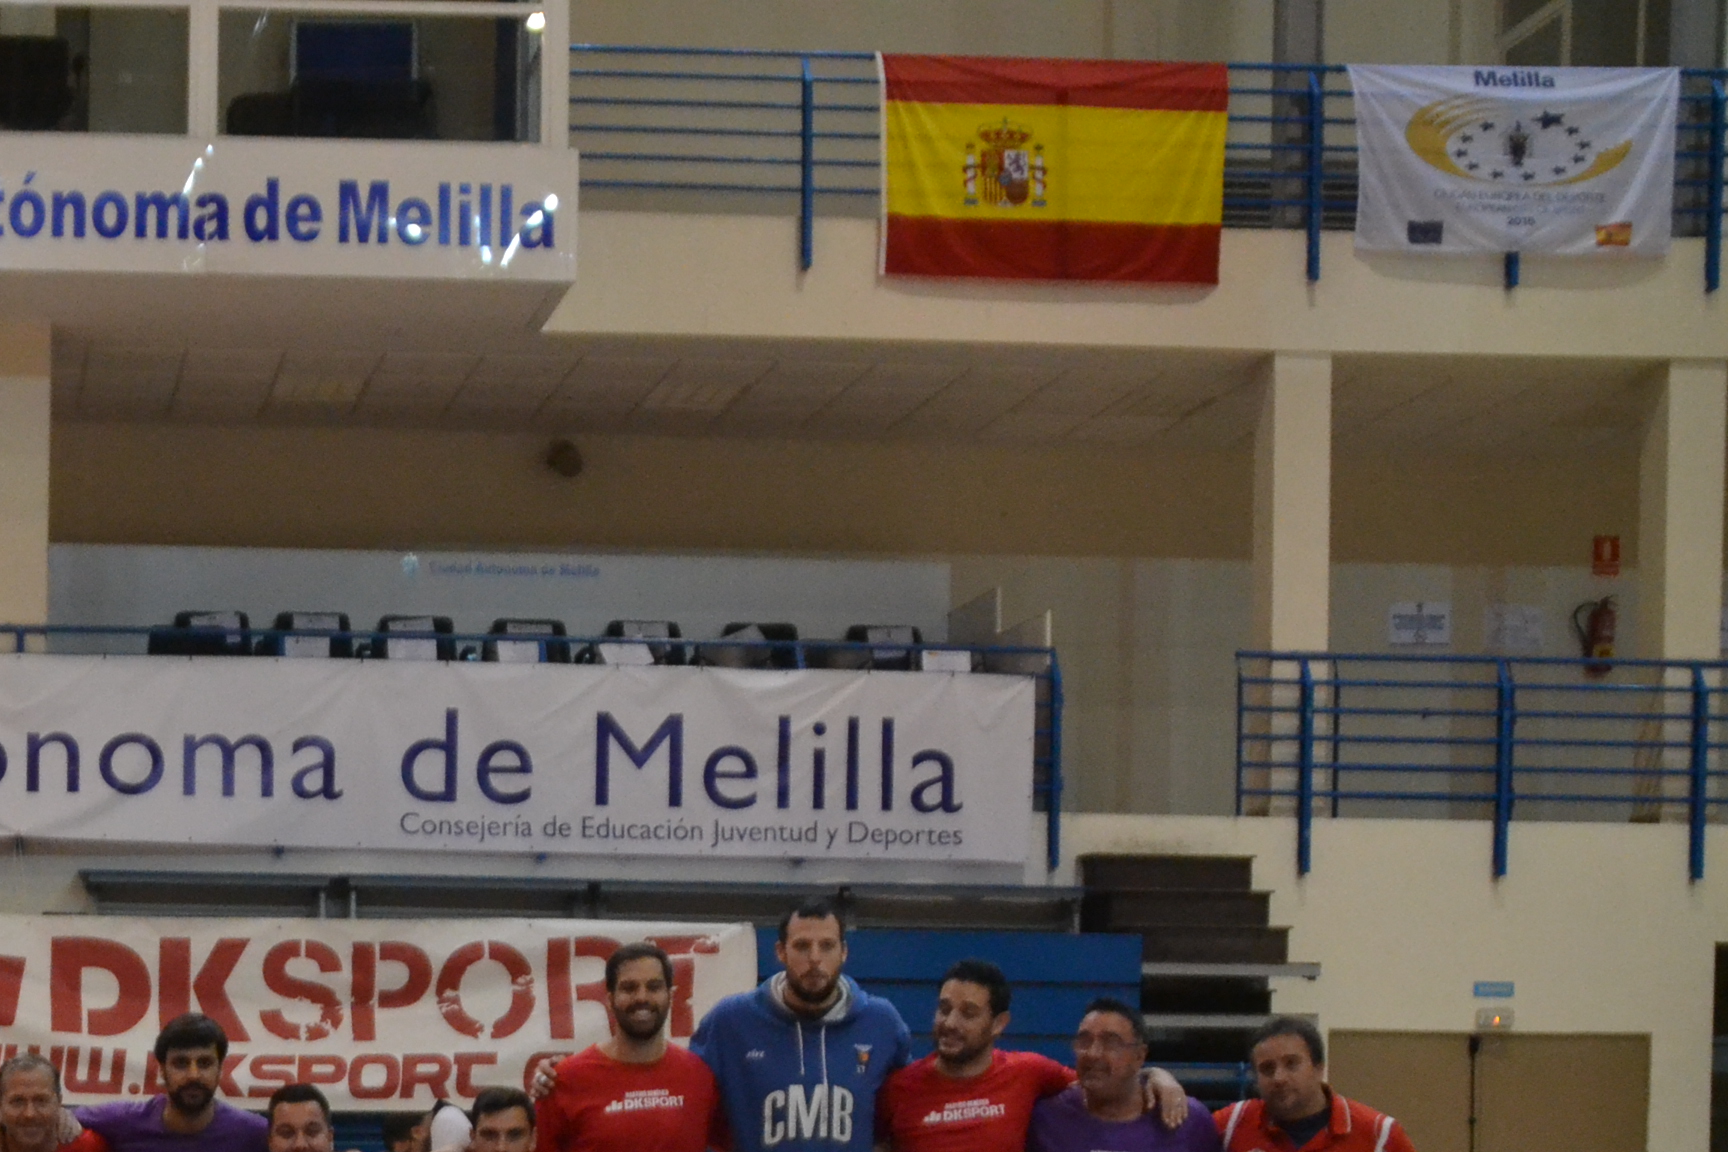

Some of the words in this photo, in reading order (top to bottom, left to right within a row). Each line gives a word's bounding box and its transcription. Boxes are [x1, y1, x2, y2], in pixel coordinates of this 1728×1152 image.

[1473, 70, 1556, 88] Melilla
[243, 176, 323, 243] de
[338, 179, 556, 249] Melilla
[400, 708, 534, 805] de
[595, 710, 964, 816] Melilla
[400, 811, 532, 841] Consejería
[543, 816, 571, 838] de
[581, 816, 704, 842] Educación
[711, 820, 818, 848] Juventud
[825, 827, 838, 848] y
[848, 821, 963, 853] Deportes
[50, 935, 720, 1042] DKSPORT
[624, 1095, 684, 1110] DKSPORT
[762, 1084, 854, 1145] CMB
[942, 1104, 1005, 1122] DKSPORT
